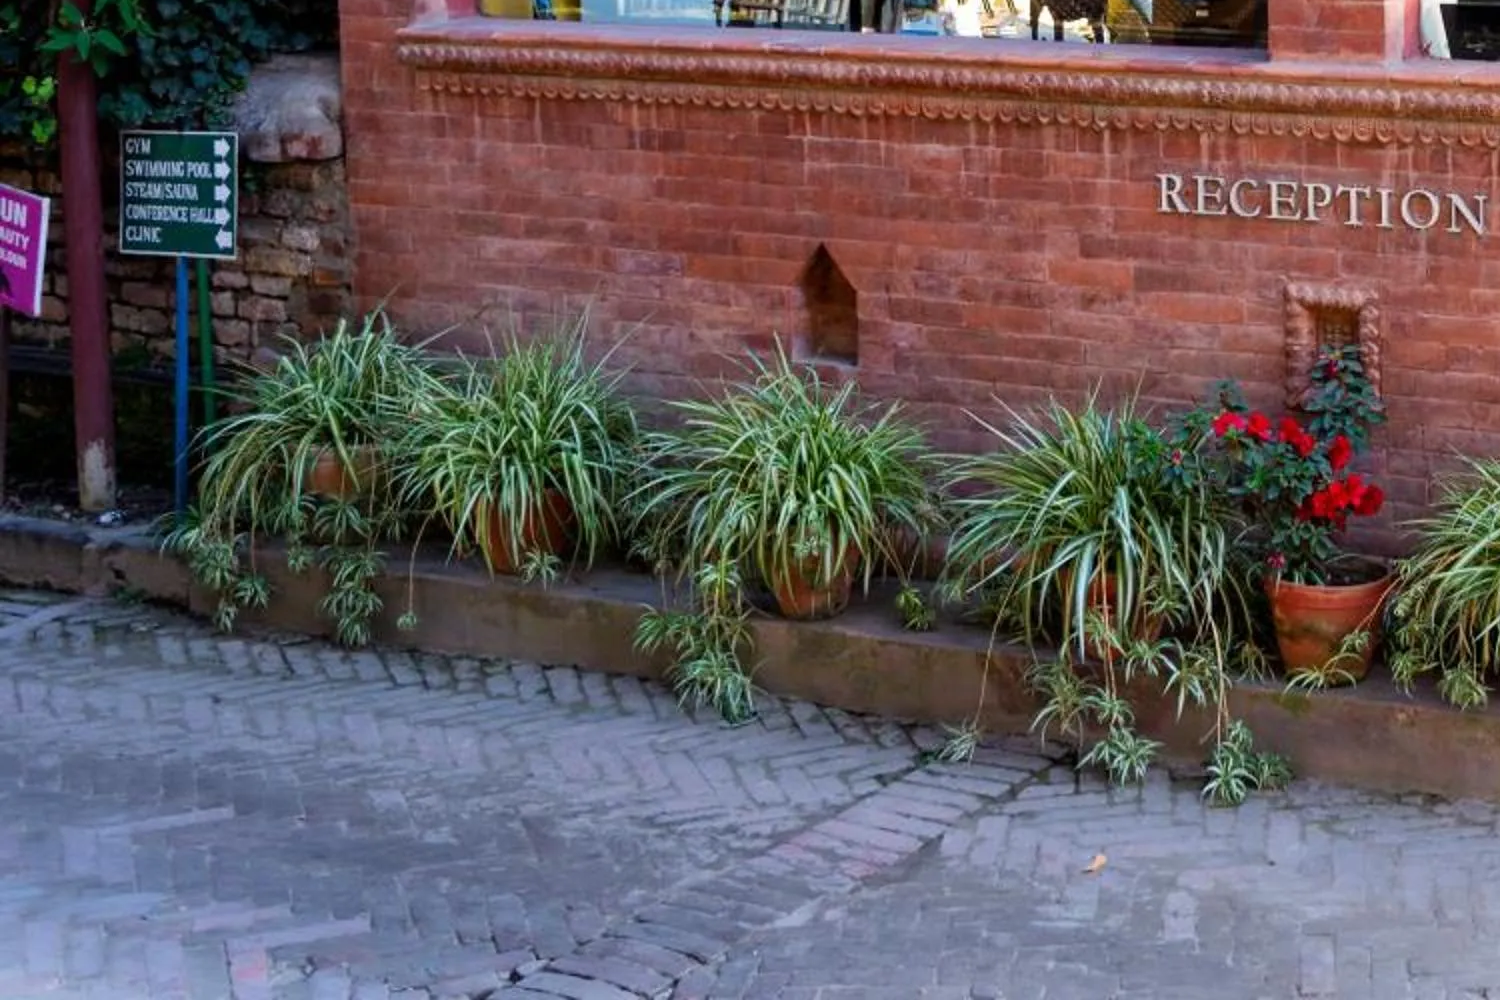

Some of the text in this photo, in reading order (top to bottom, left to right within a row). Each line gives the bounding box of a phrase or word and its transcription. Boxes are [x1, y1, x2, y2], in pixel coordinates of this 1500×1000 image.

[125, 138, 151, 154] GYM
[125, 160, 212, 179] SWIMMING POOL
[125, 204, 188, 223] CONFERENCE
[1156, 173, 1489, 235] RECEPTION
[125, 226, 163, 244] CLINIC
